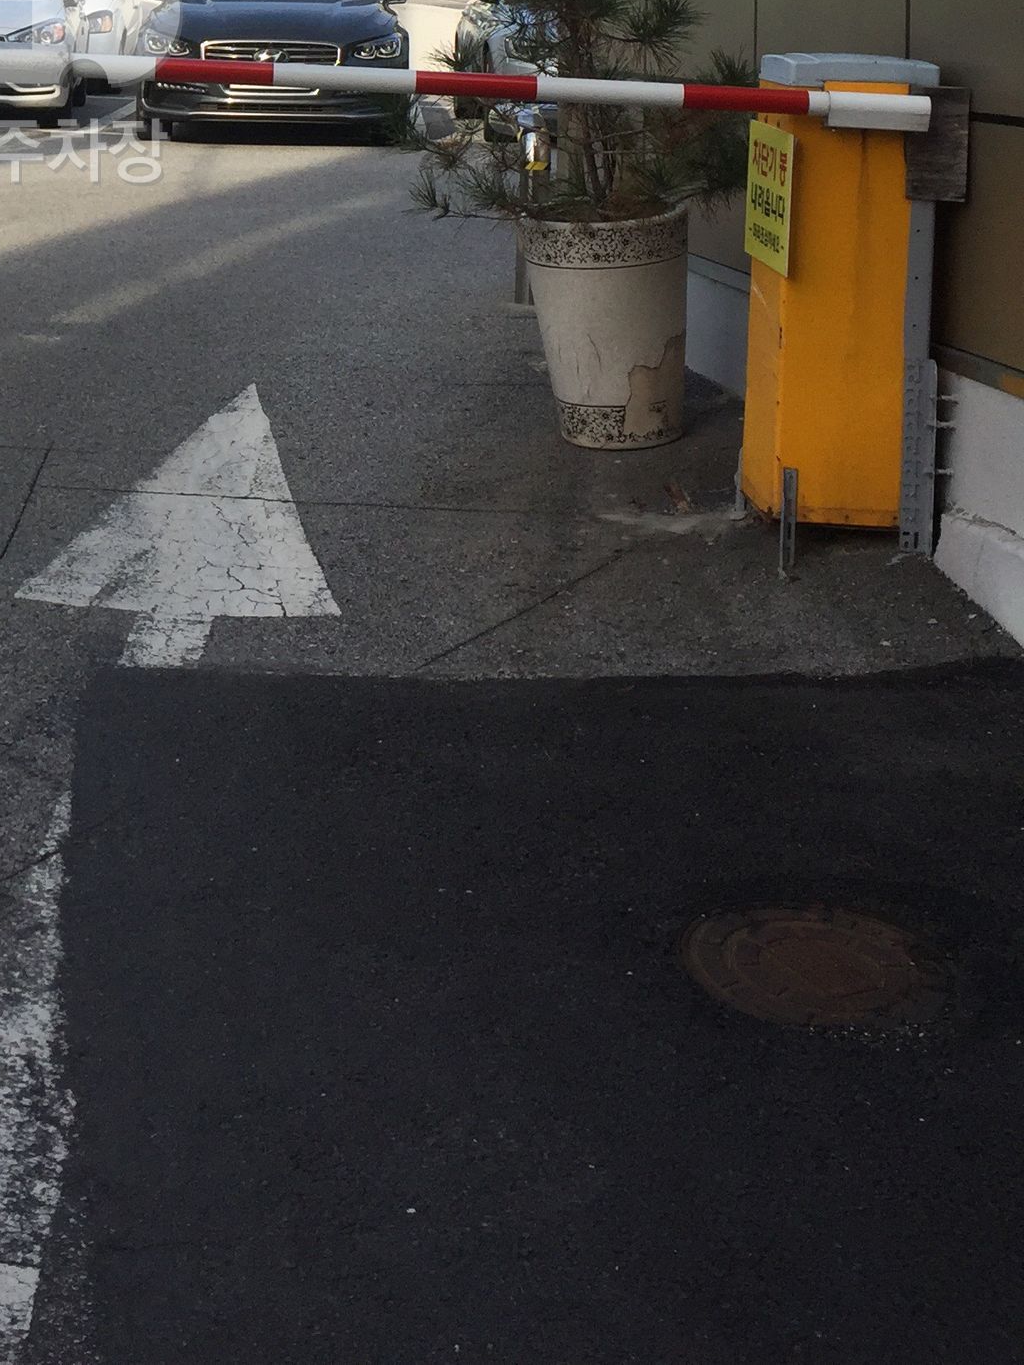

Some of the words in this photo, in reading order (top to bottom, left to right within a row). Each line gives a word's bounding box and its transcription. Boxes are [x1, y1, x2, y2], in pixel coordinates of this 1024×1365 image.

[752, 138, 777, 181] 차단기
[779, 148, 788, 187] 봉
[751, 182, 786, 225] 내려옵니다
